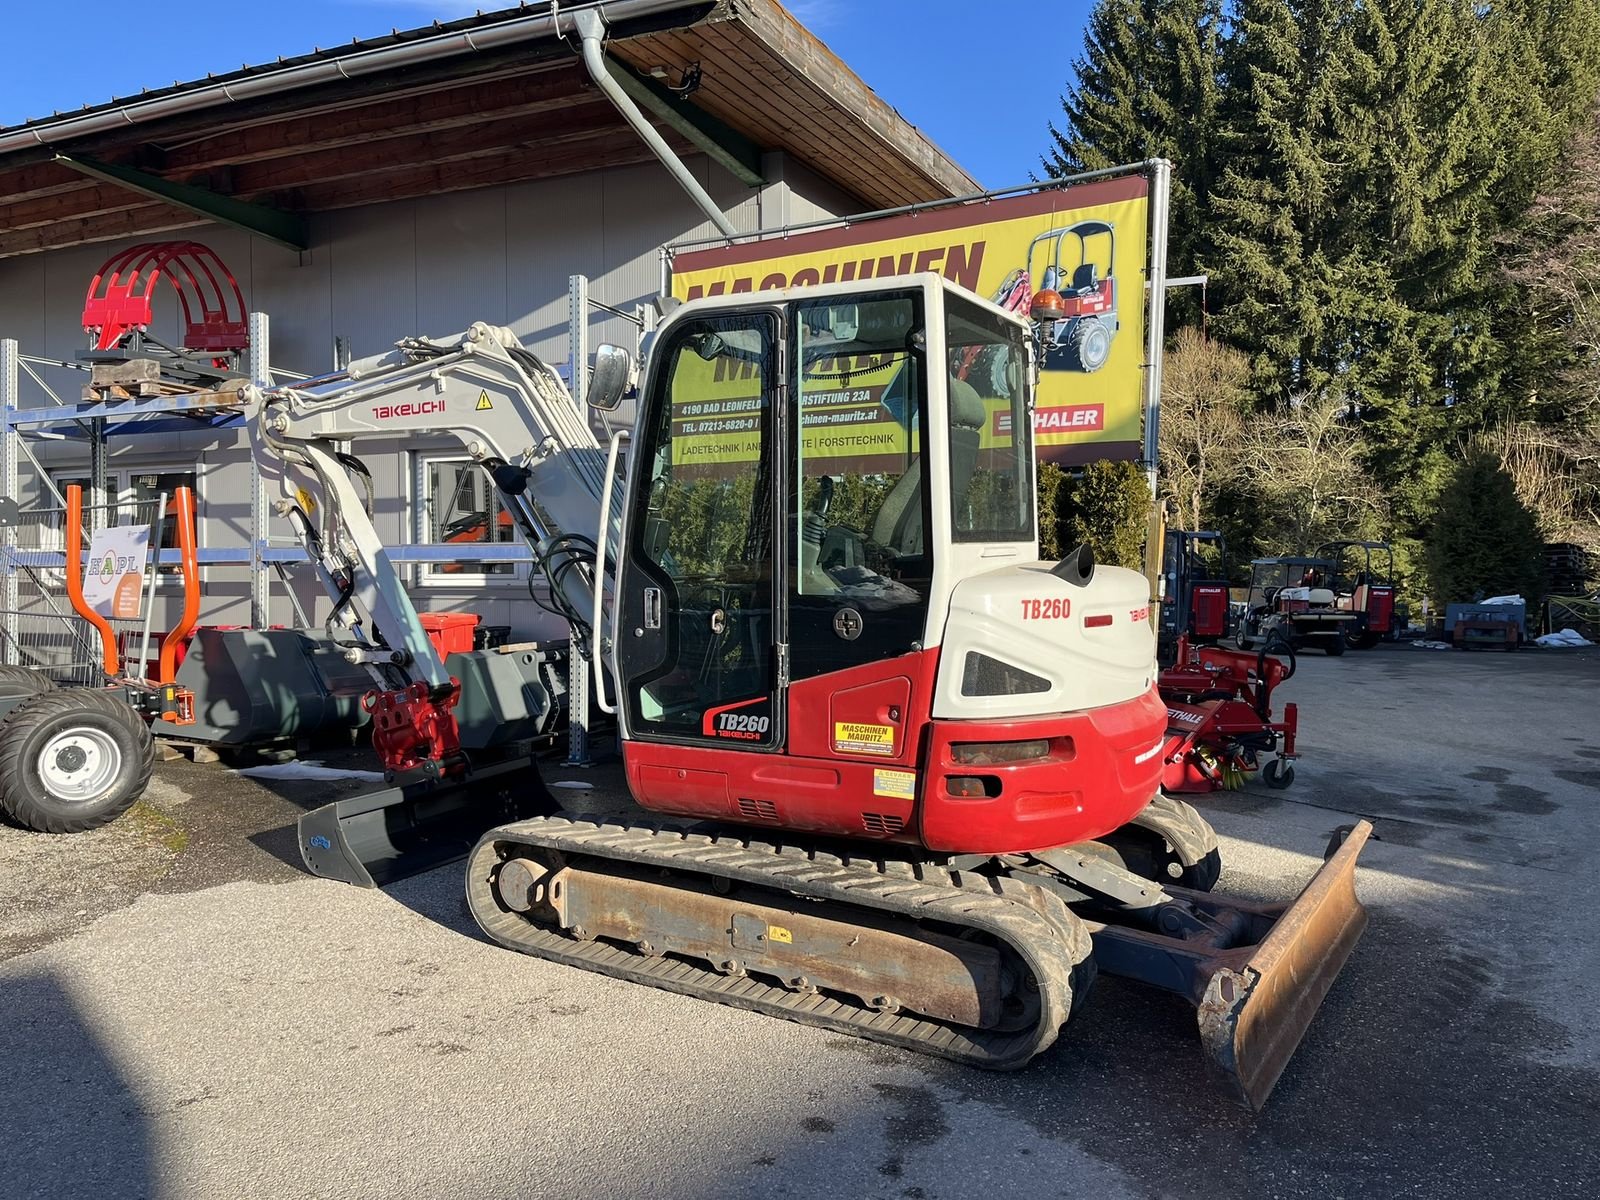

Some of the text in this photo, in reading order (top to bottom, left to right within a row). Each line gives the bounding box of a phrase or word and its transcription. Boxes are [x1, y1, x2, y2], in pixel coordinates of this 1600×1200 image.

[372, 400, 445, 419] TAKEUCHI
[682, 390, 871, 415] 4190 BAD LEONFELD RSTIFTUNG 23A
[682, 424, 697, 433] TEL.
[800, 409, 878, 425] chinen-mauritz.at
[682, 444, 740, 455] LADETECHNIK
[819, 434, 894, 448] FORSTTECHNIK
[88, 556, 138, 575] HAPL
[1021, 598, 1071, 620] TB260
[720, 713, 770, 733] TB260
[841, 725, 888, 735] MASCHINEN
[718, 730, 760, 740] TAKEUCHI
[847, 733, 883, 742] MAURITZ
